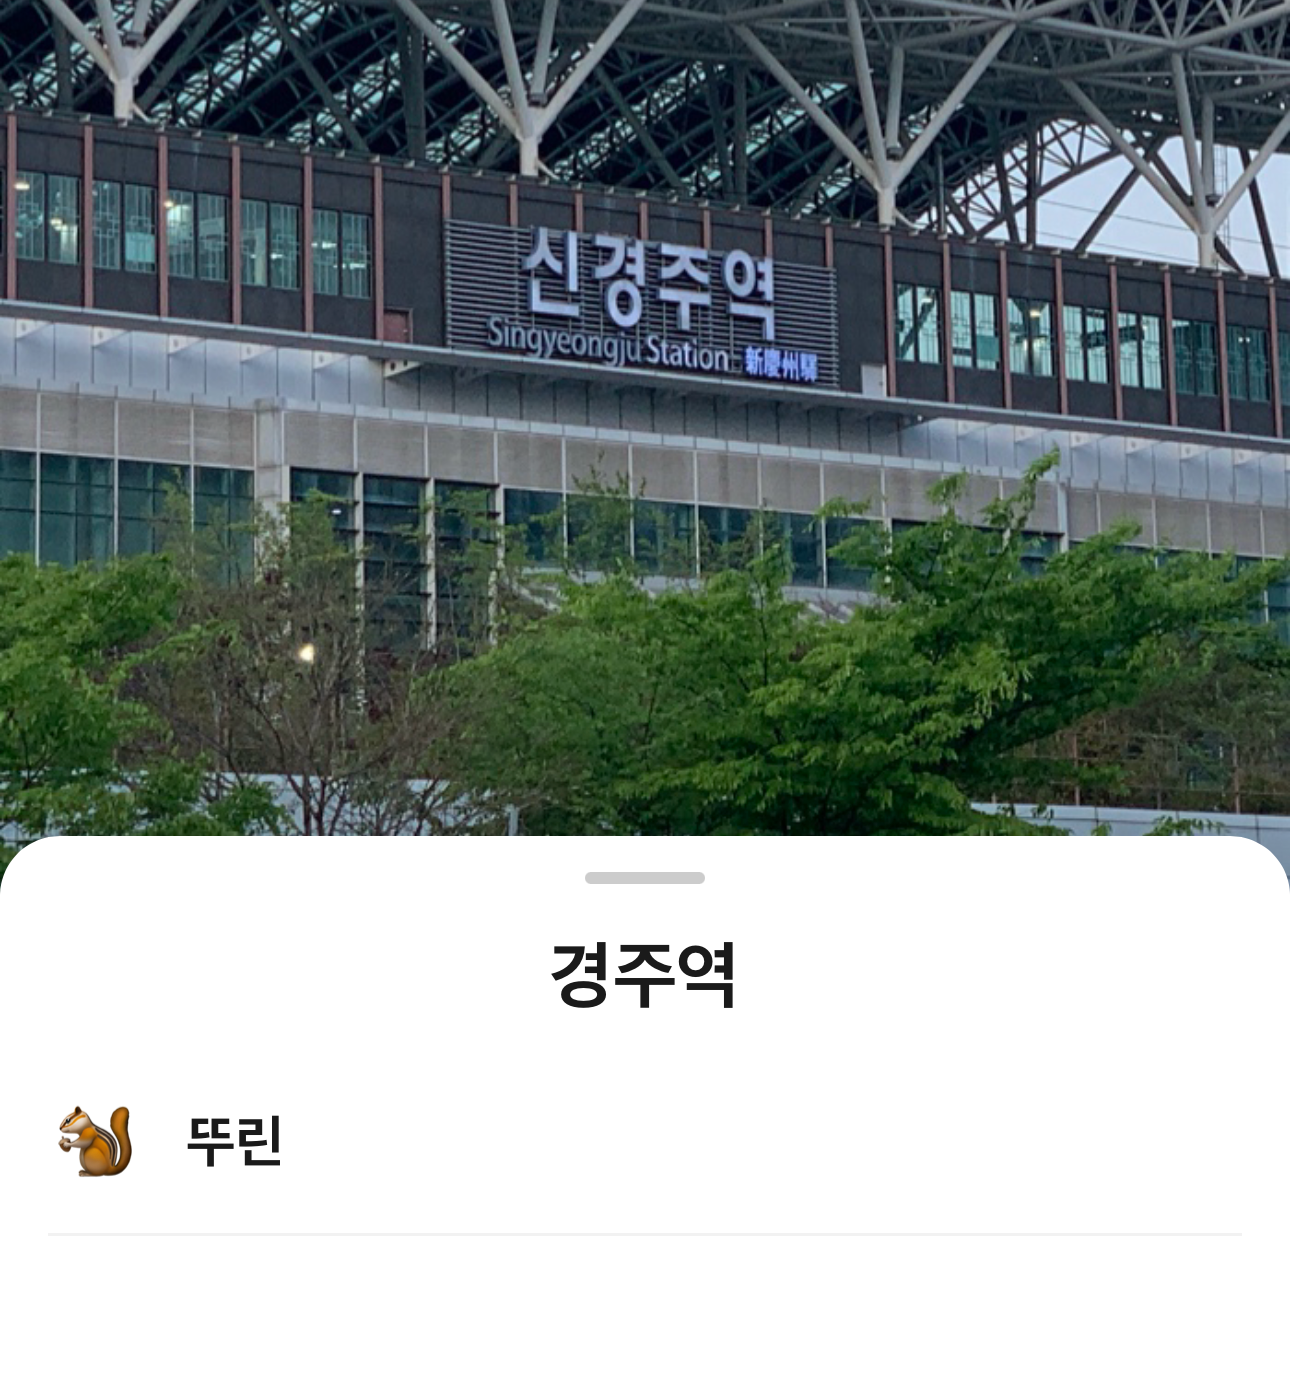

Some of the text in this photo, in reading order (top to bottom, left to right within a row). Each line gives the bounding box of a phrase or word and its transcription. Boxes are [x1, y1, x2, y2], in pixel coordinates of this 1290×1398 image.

[522, 226, 776, 341] 신경주역
[487, 316, 730, 371] Singyeongju Station
